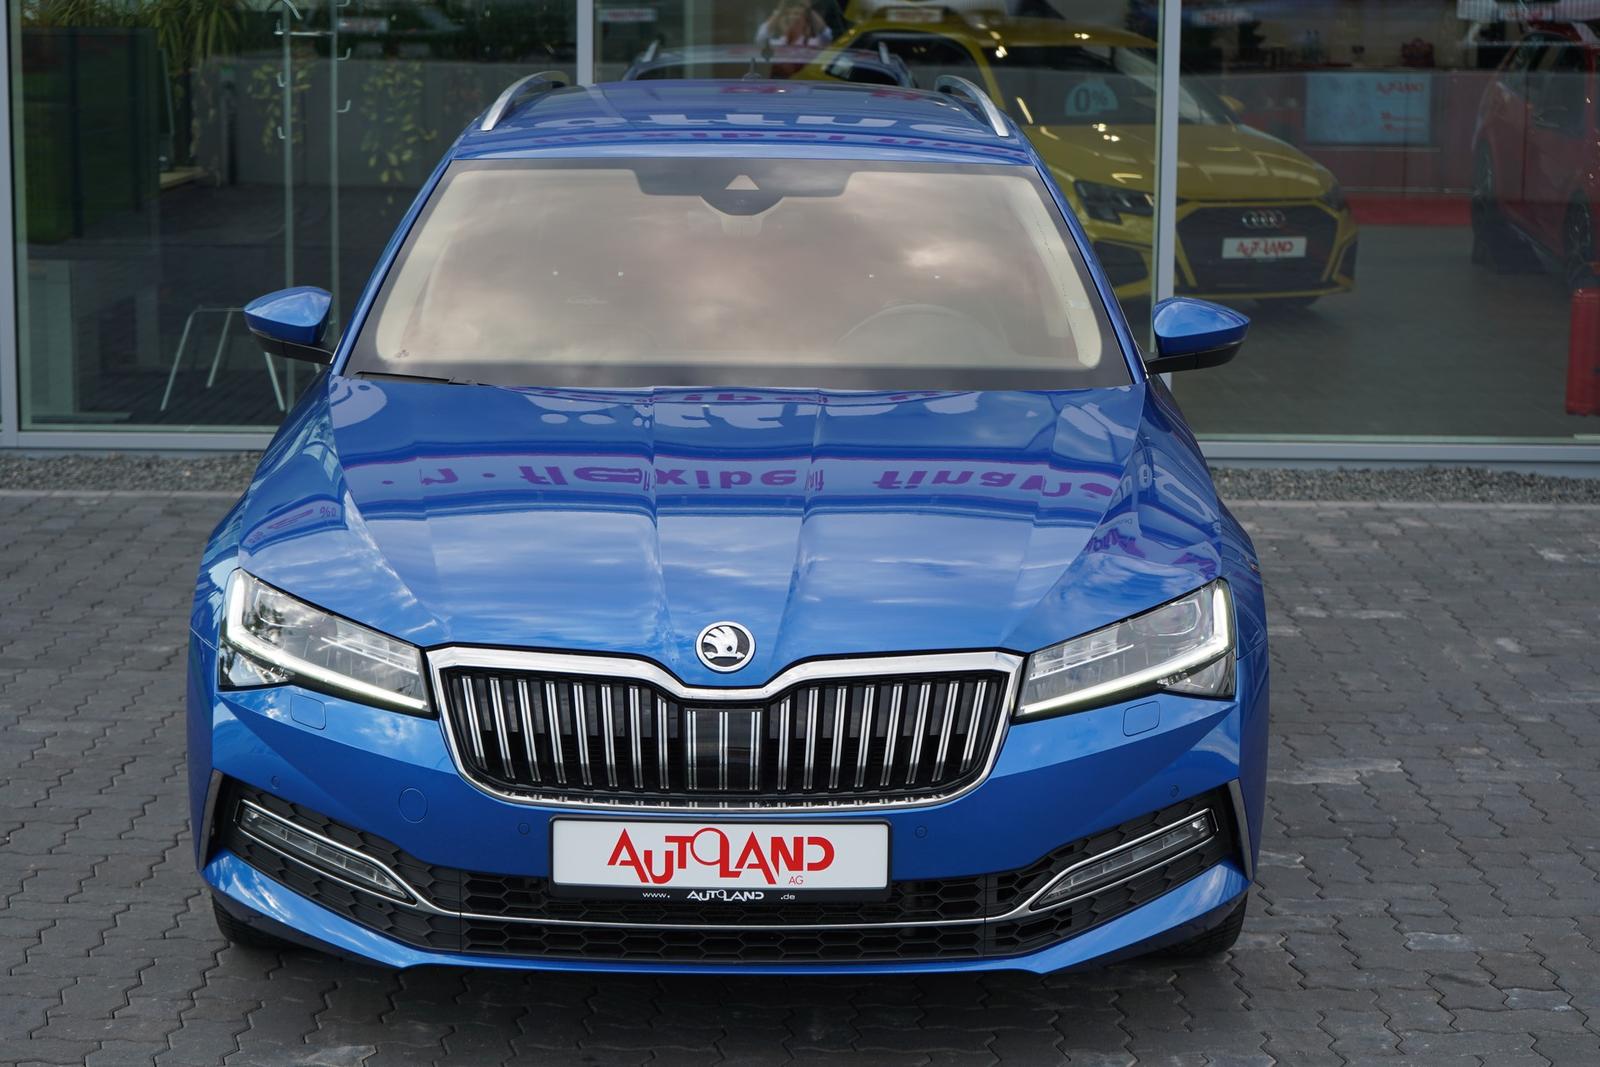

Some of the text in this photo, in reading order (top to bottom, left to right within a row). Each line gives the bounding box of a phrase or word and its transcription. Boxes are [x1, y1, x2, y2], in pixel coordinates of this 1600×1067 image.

[1074, 87, 1109, 112] 0%
[607, 827, 835, 885] AUTOLAND
[788, 875, 804, 885] AG
[686, 889, 765, 902] AUTOLAND
[780, 892, 796, 900] .de
